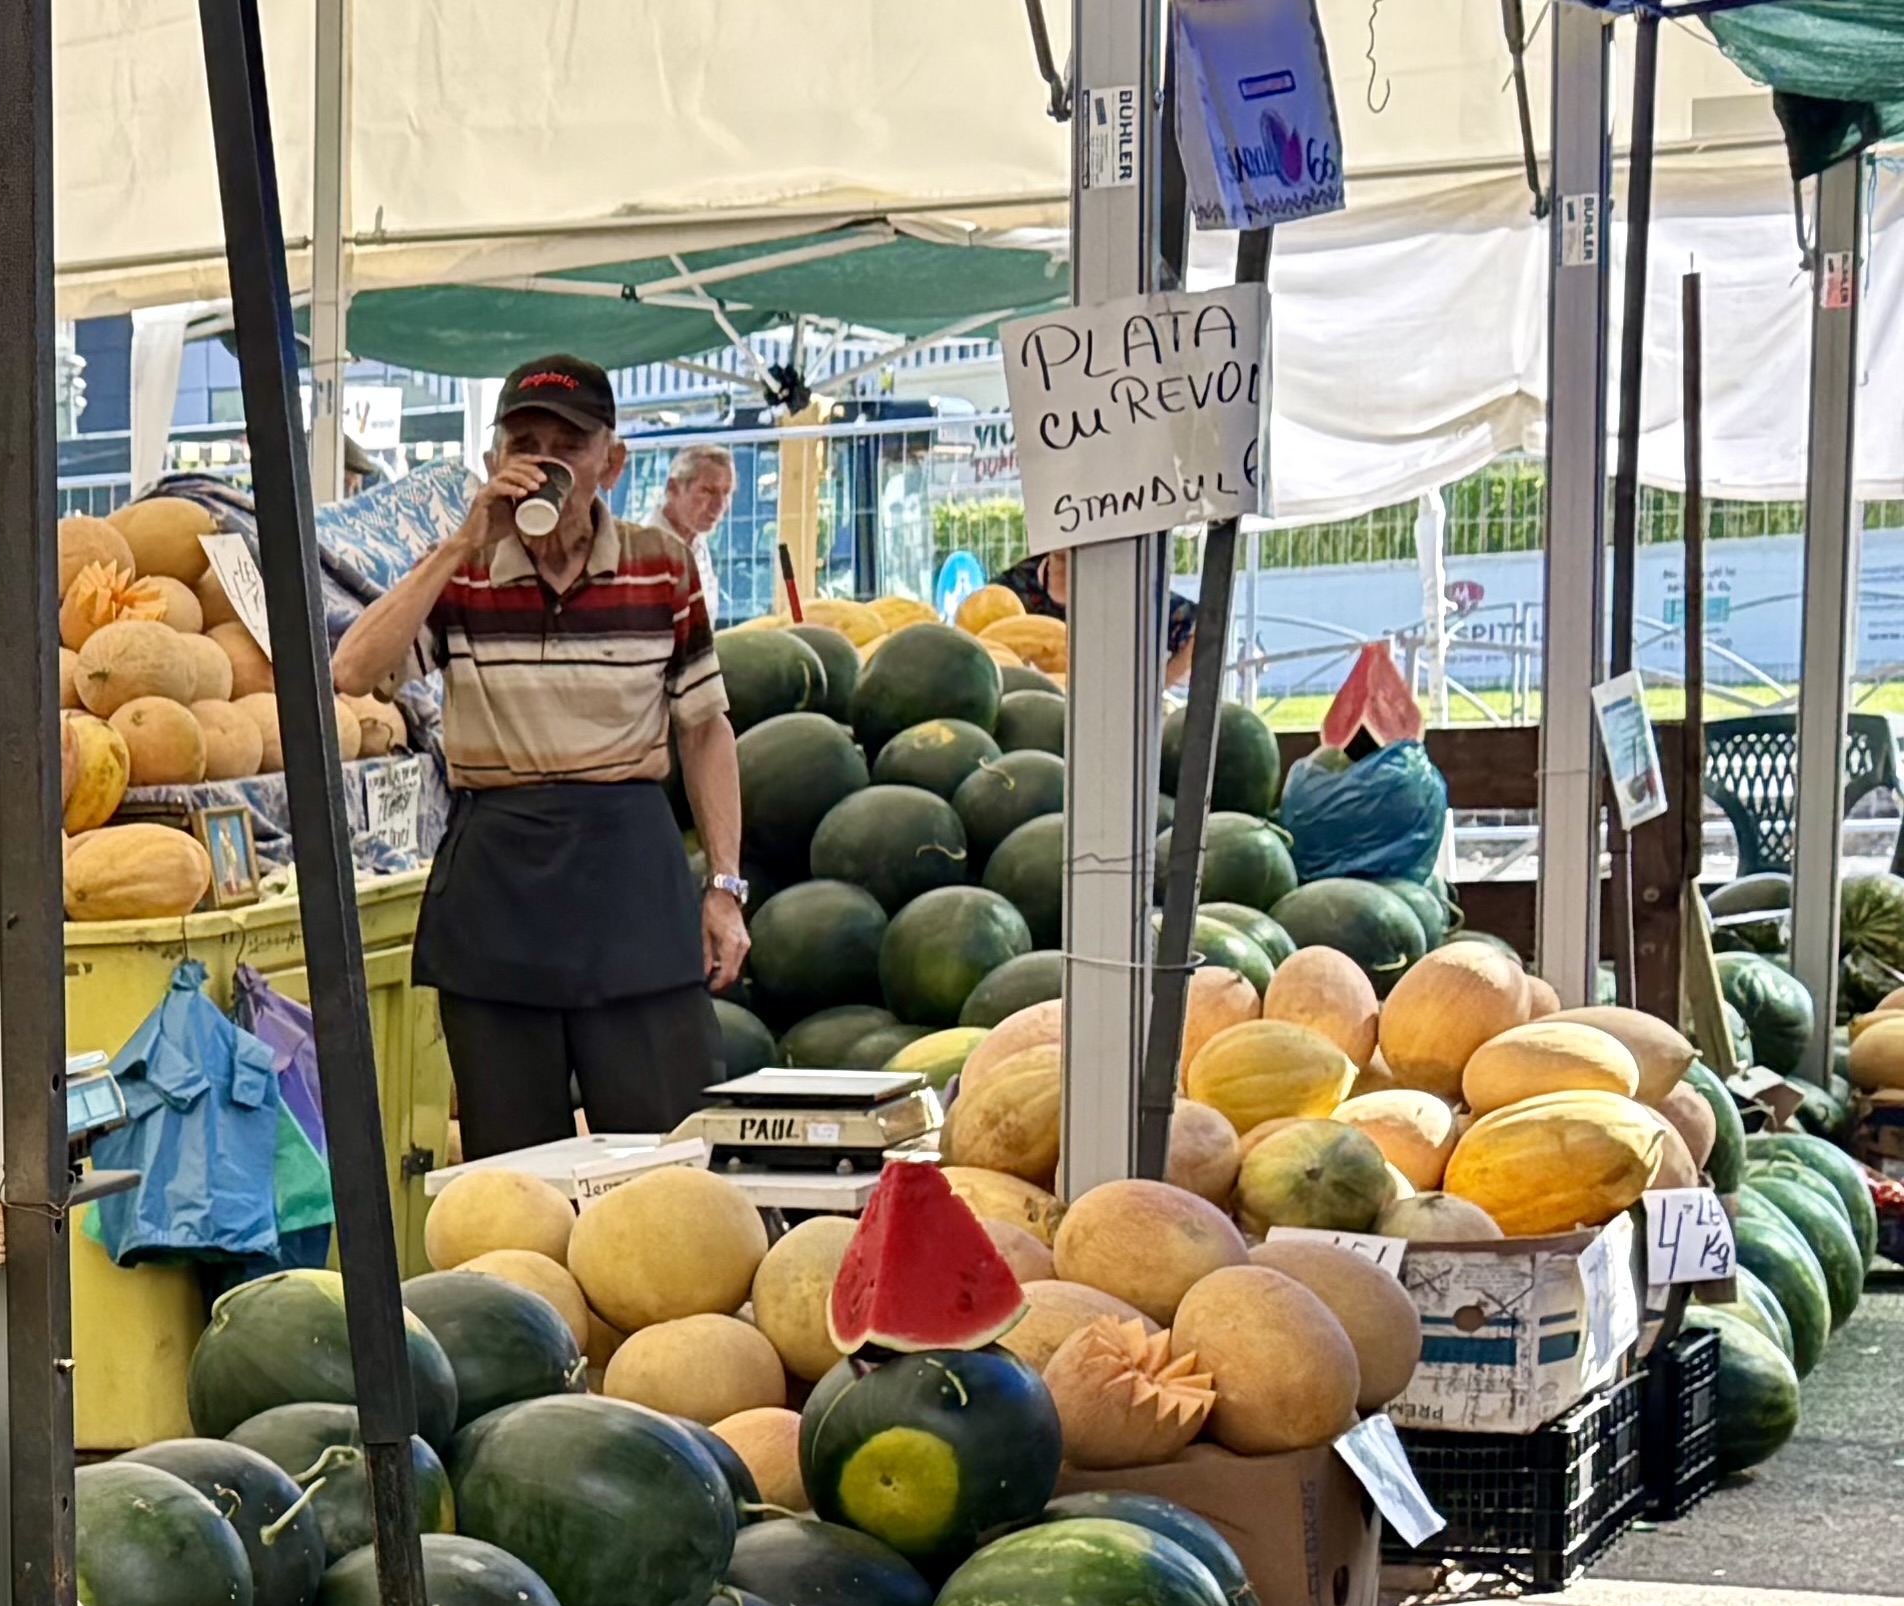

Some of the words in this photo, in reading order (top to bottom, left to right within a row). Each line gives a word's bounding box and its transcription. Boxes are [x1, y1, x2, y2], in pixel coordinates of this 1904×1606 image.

[1021, 305, 1237, 391] PLATA
[1054, 472, 1239, 533] STANDUL
[739, 1118, 800, 1141] PAUL
